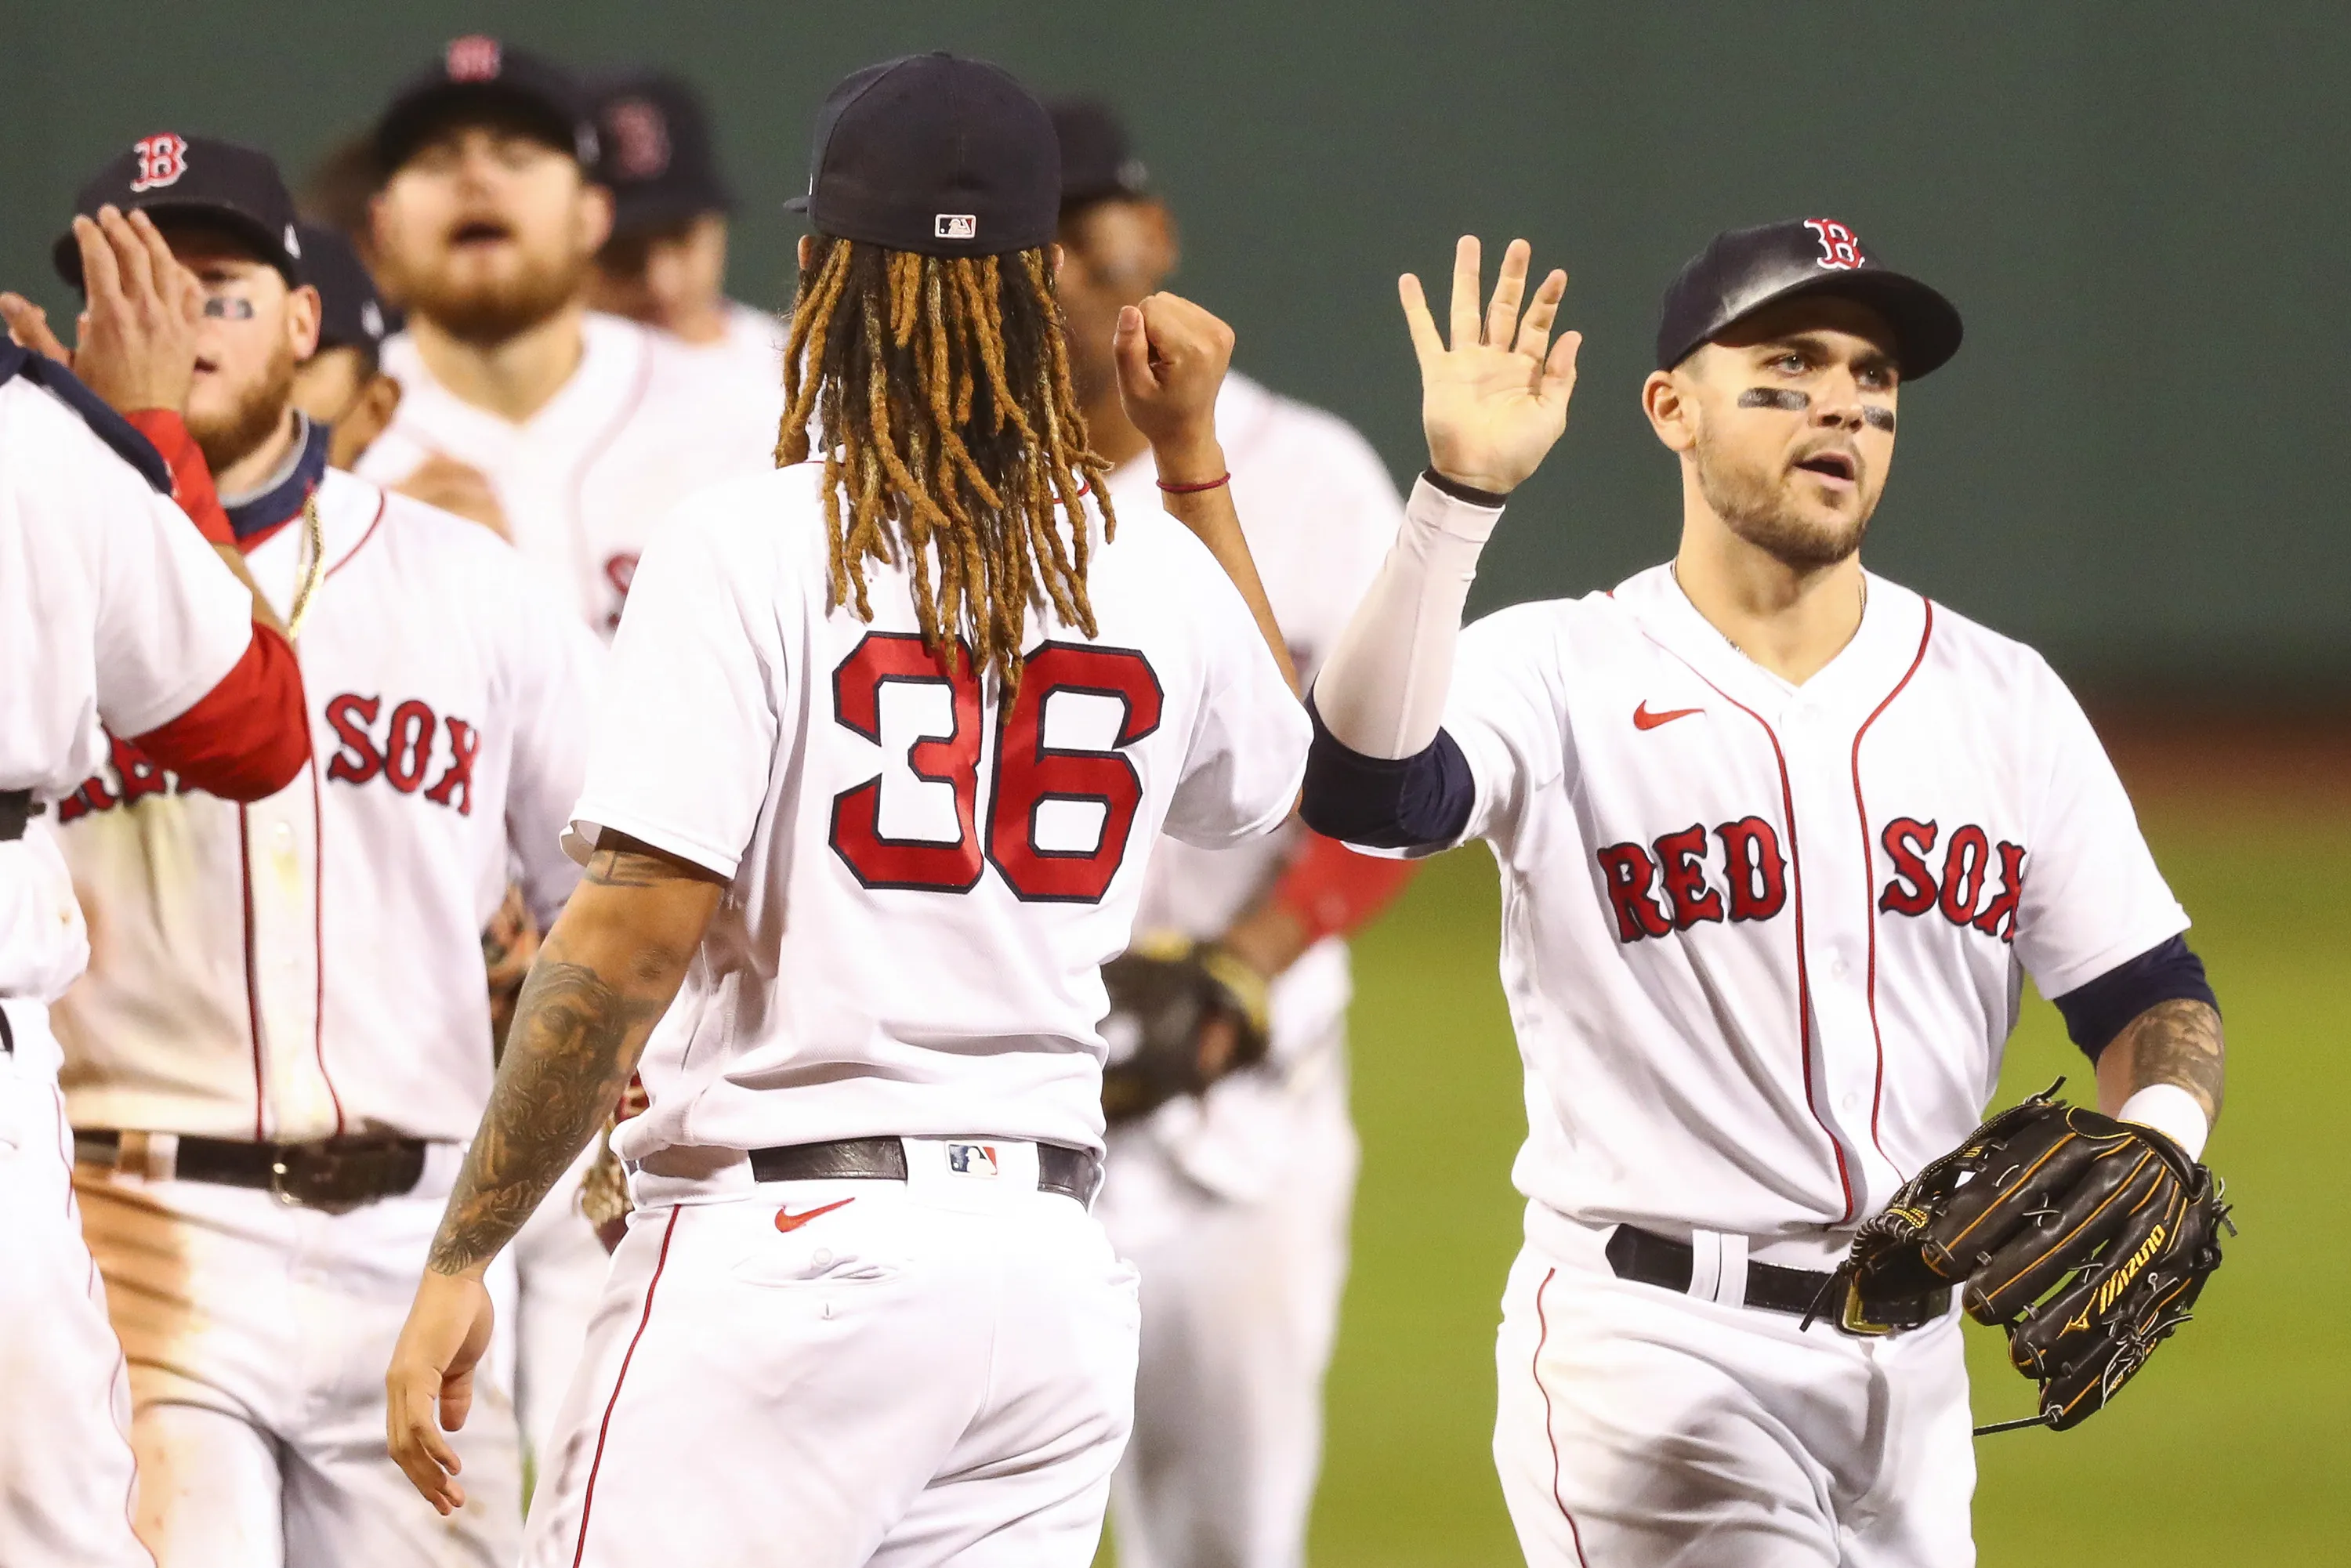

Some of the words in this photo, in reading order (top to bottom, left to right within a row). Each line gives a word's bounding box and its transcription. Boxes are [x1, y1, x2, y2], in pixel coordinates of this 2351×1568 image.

[129, 132, 189, 193] B
[1803, 218, 1865, 270] B
[324, 693, 482, 818] SOX
[828, 630, 1164, 904] 36
[1596, 815, 1788, 943] RED
[1878, 816, 2027, 947] SOX
